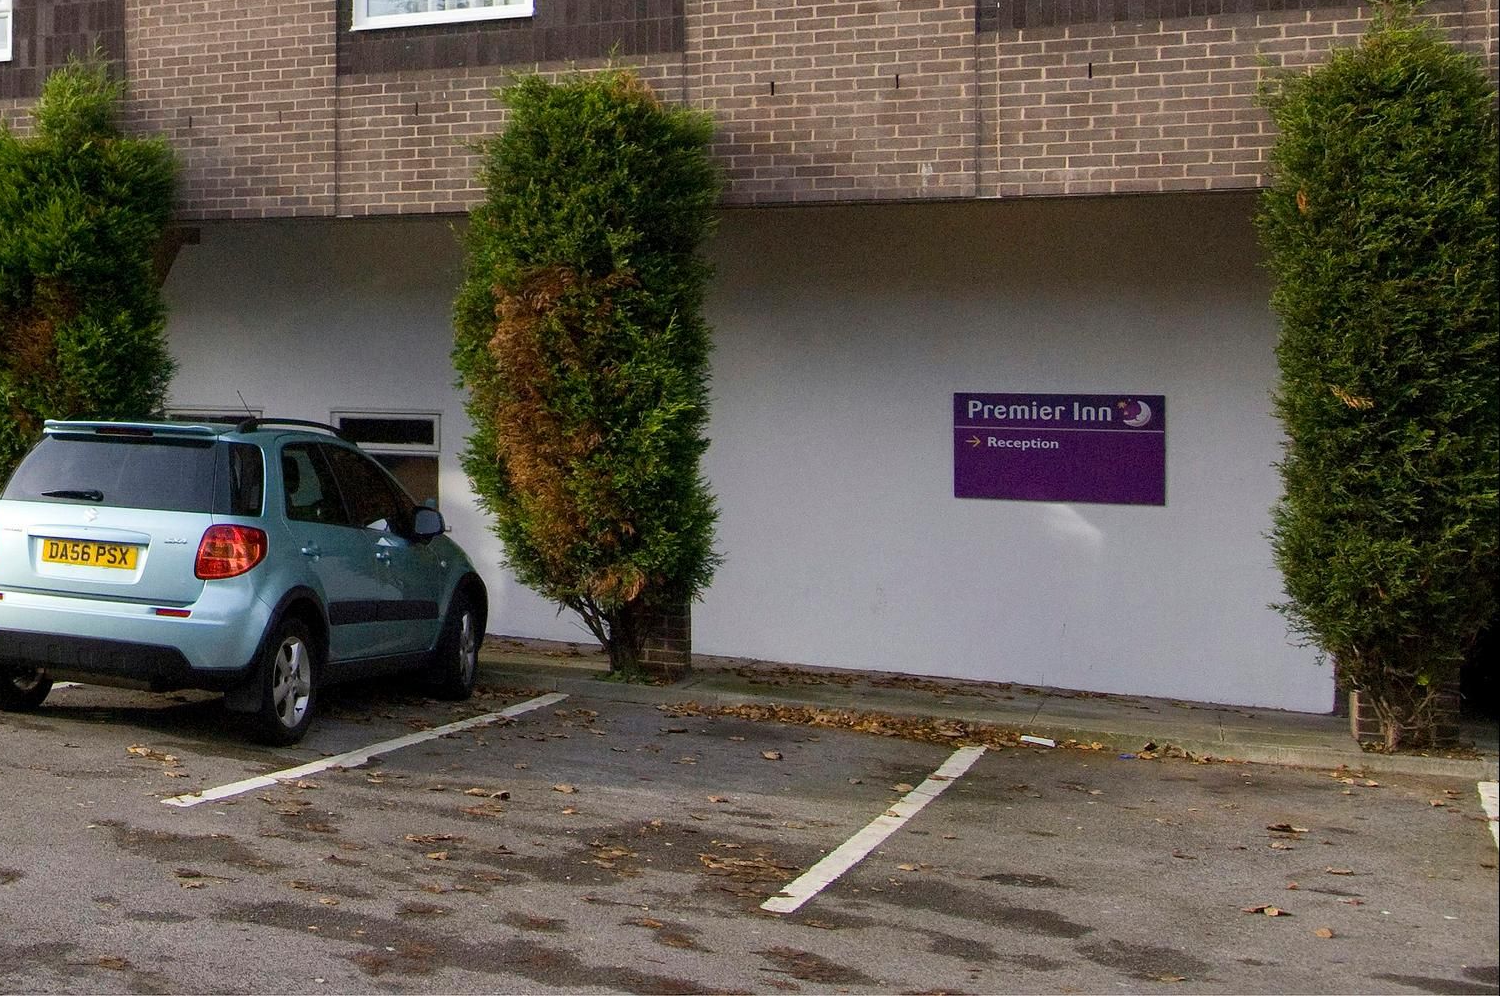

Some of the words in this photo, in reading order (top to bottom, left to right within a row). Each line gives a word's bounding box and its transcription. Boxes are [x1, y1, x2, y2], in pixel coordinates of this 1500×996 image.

[968, 400, 1065, 420] Premier
[1073, 402, 1112, 421] Inn
[987, 436, 1059, 450] Reception
[49, 542, 90, 561] DA56
[95, 546, 129, 565] PSX
